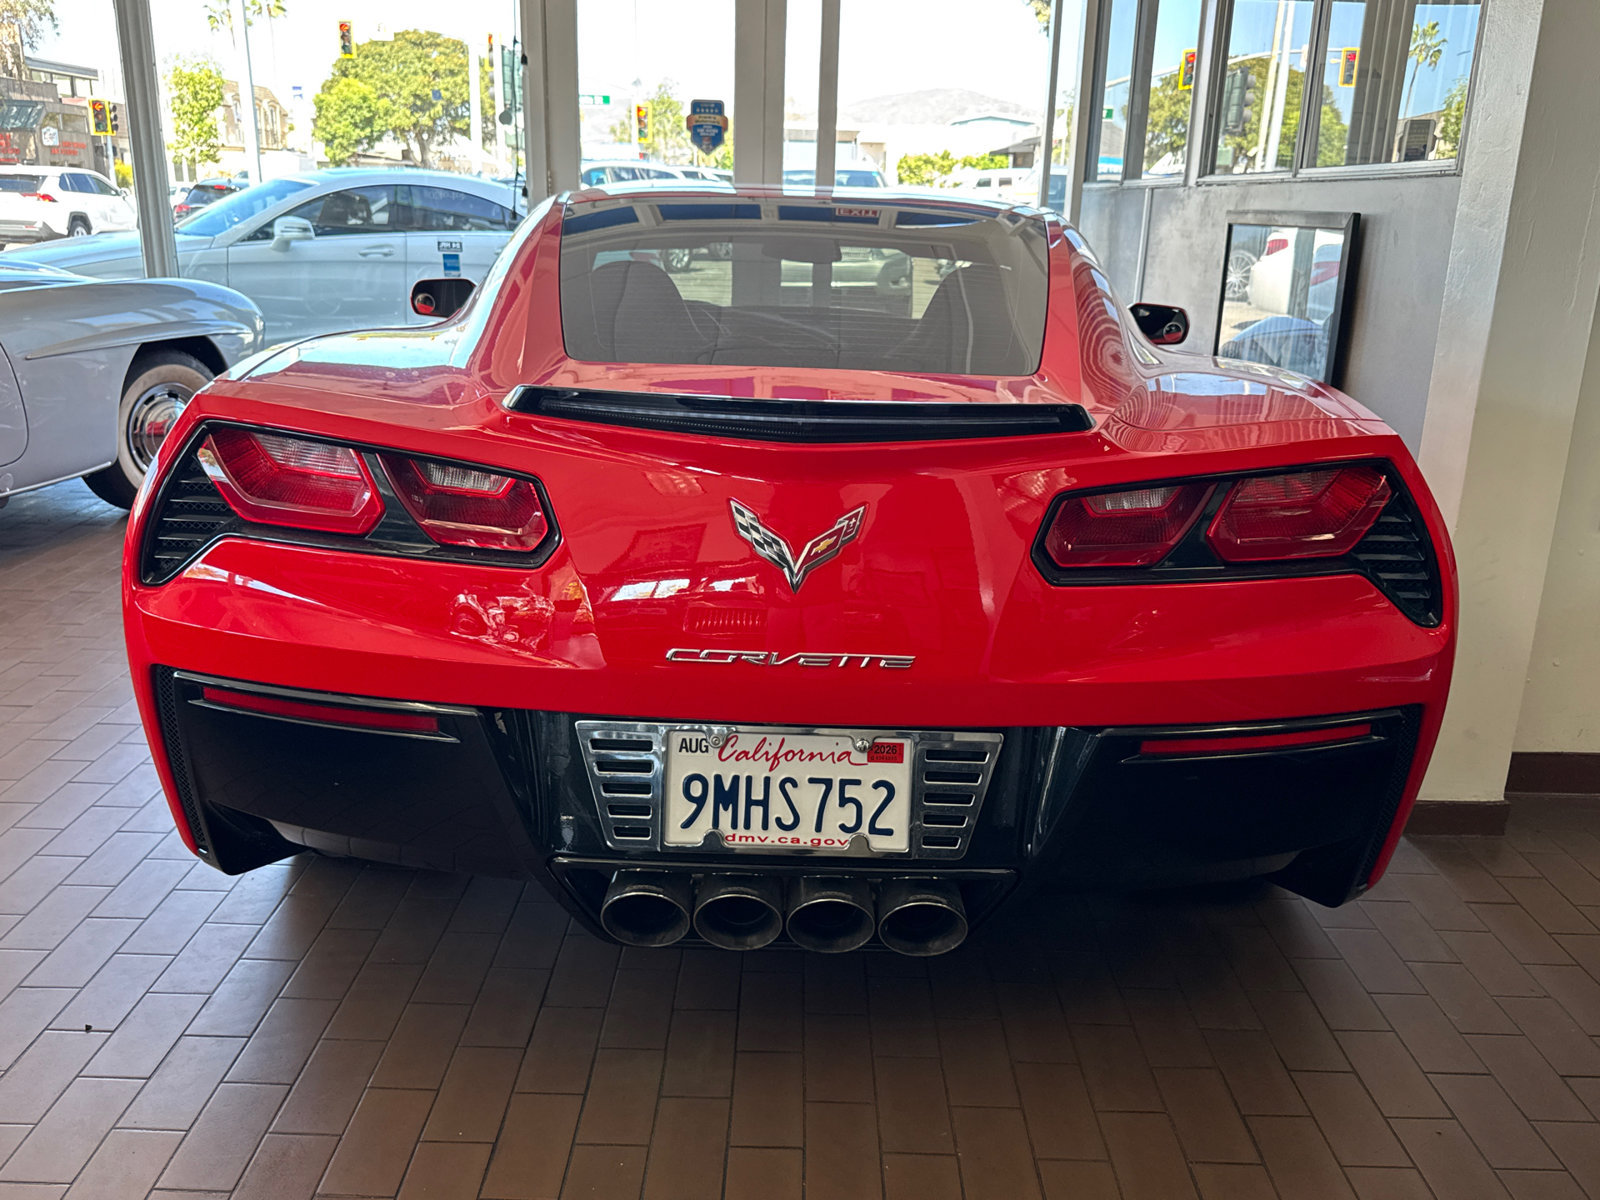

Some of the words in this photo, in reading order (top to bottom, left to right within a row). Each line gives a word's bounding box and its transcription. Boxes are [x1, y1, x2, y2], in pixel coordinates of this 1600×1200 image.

[665, 648, 916, 668] CORVETTE
[679, 738, 709, 753] AUG
[717, 735, 869, 772] California
[874, 745, 897, 755] 2026
[680, 773, 896, 836] 9MHS752
[725, 834, 850, 847] dmv.ca.gov
